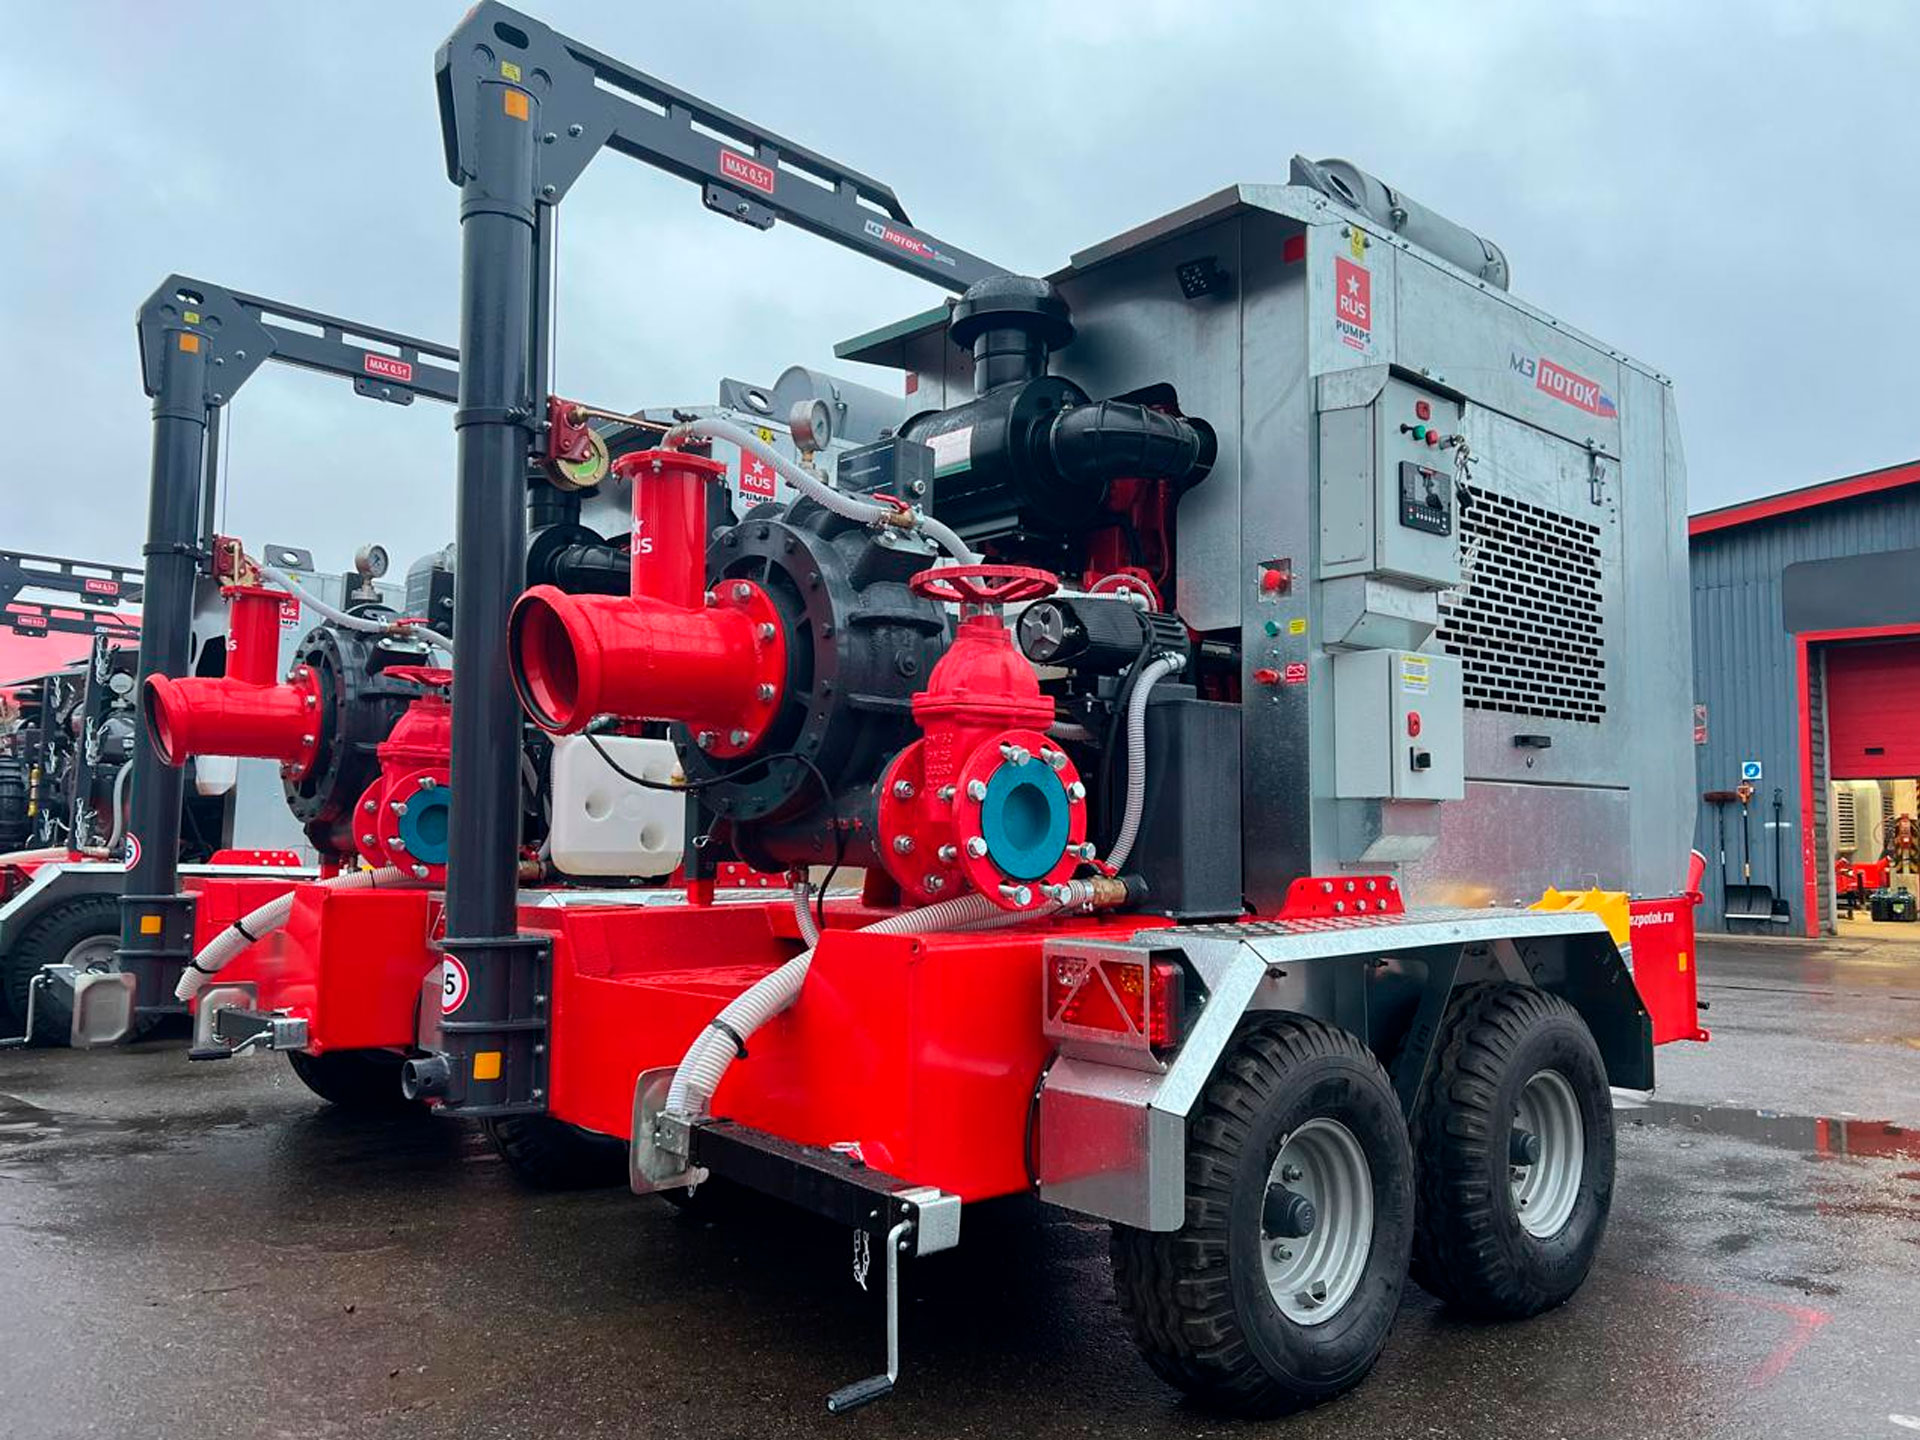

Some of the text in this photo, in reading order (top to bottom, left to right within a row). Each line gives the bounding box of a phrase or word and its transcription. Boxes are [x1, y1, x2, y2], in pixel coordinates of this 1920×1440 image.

[726, 157, 749, 178] MAX
[885, 230, 921, 252] ПОТОК
[1340, 294, 1367, 319] RUS
[1336, 319, 1371, 343] PUMPS
[1541, 365, 1597, 408] ПОТОК
[744, 473, 771, 490] RUS
[630, 537, 653, 555] US
[280, 605, 297, 617] US
[444, 972, 456, 996] 5
